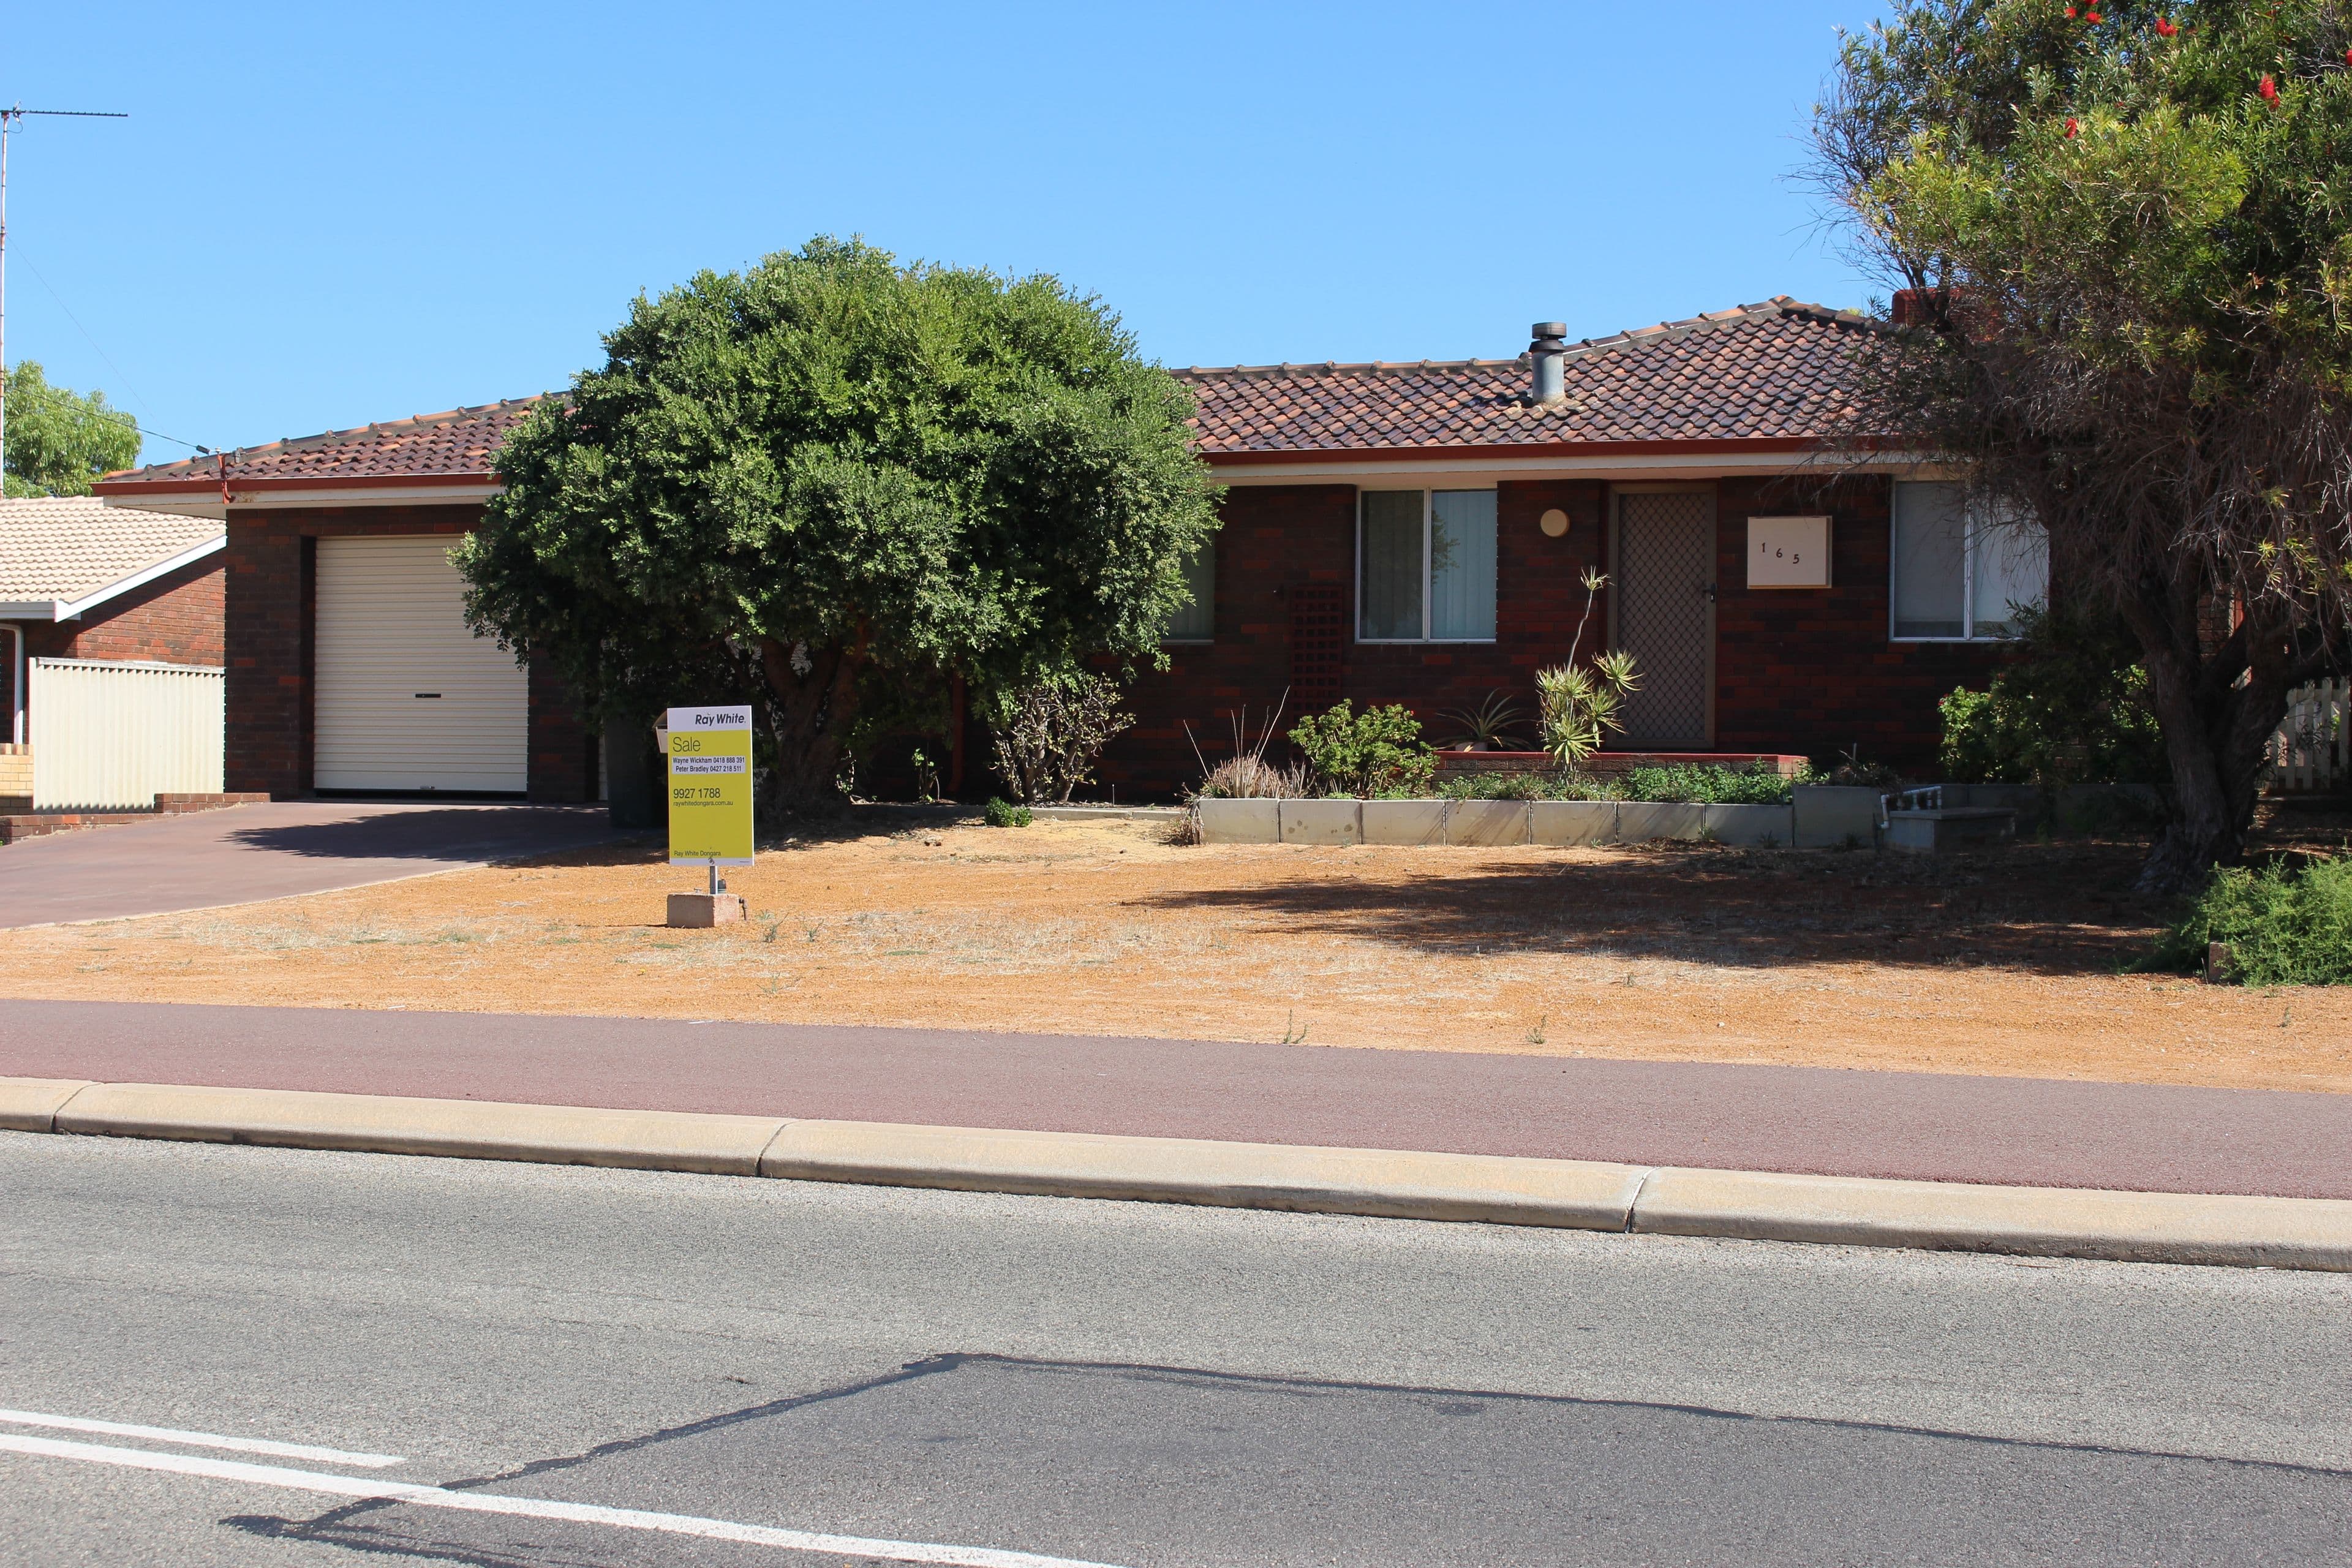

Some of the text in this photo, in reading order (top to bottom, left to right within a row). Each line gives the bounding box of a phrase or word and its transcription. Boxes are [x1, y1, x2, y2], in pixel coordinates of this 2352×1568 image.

[695, 713, 744, 726] Ray White
[673, 736, 701, 752] Sale
[673, 788, 720, 799] 9927 1788
